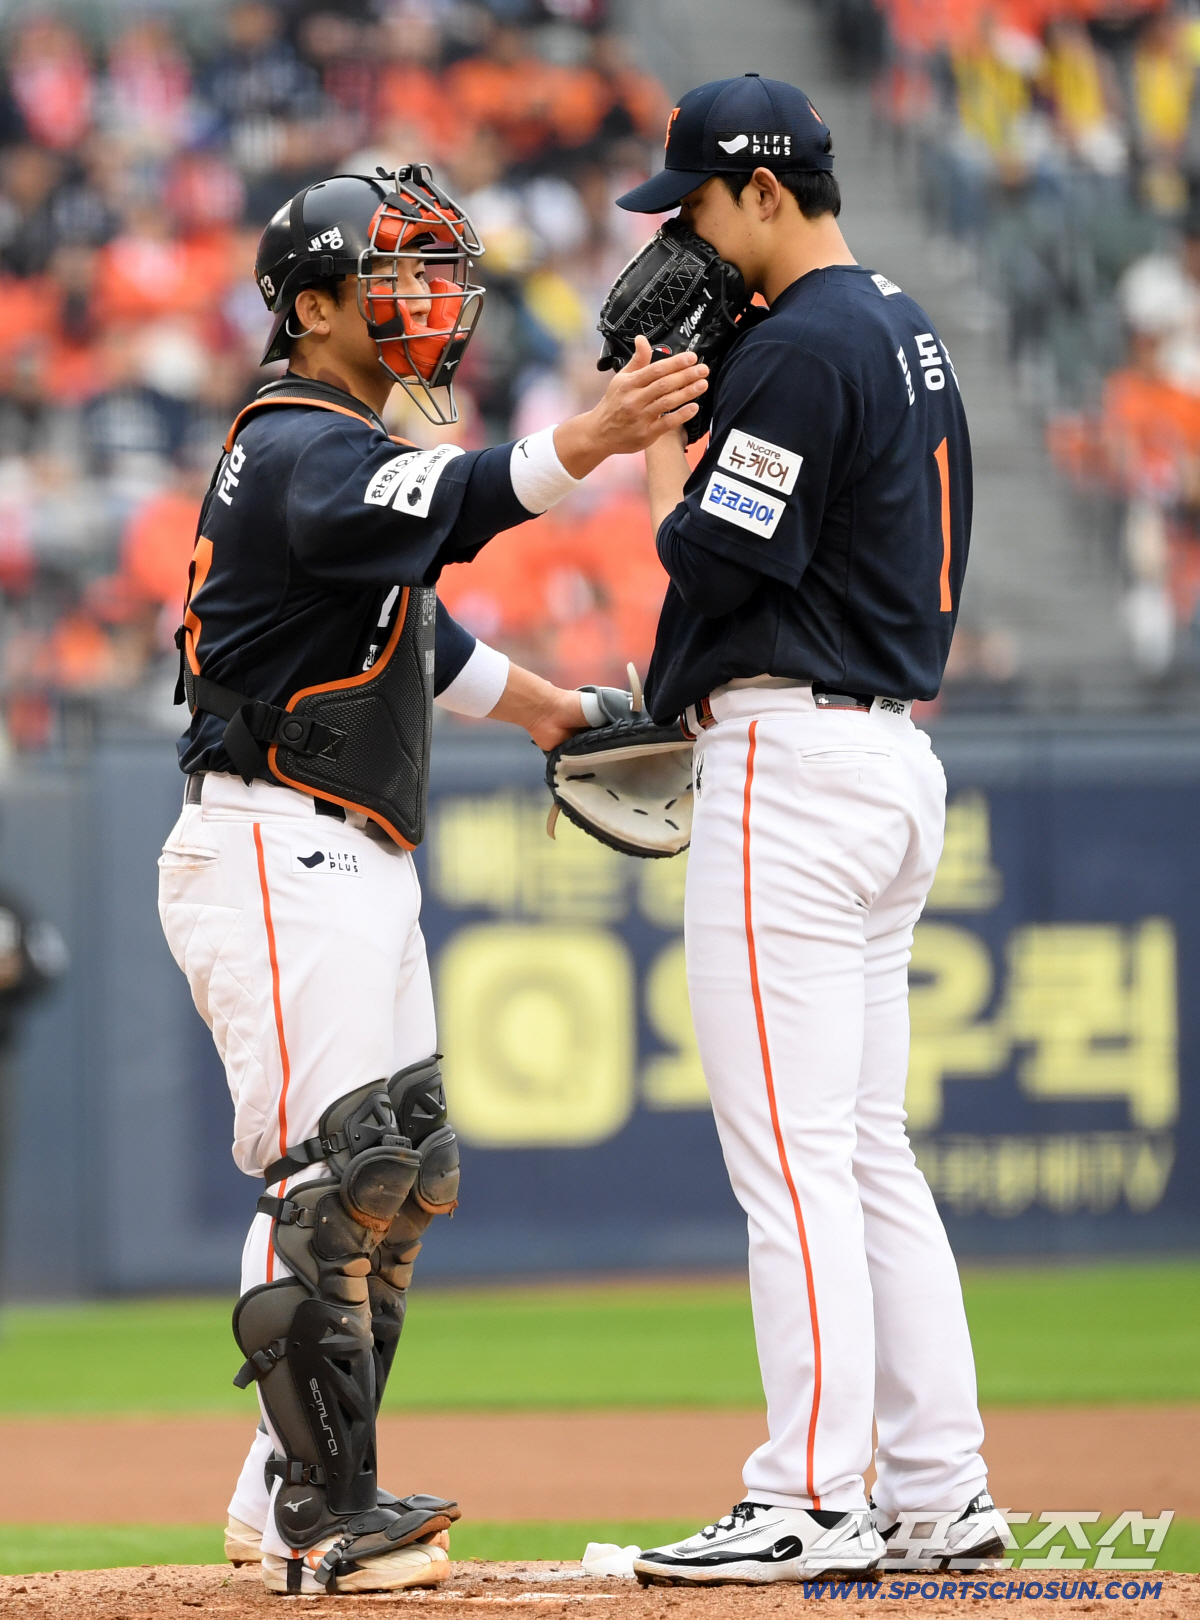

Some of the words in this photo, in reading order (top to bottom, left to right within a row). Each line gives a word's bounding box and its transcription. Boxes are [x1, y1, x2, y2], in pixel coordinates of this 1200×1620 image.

[752, 134, 791, 146] LIFE
[752, 144, 791, 156] PLUS
[260, 275, 276, 299] 13
[746, 440, 781, 460] Nucare
[729, 445, 790, 487] 뉴케어
[708, 483, 775, 526] 잡코리아
[933, 436, 952, 612] 1
[880, 698, 904, 715] SPYDER
[329, 852, 357, 863] LIFE
[330, 862, 358, 872] PLUS
